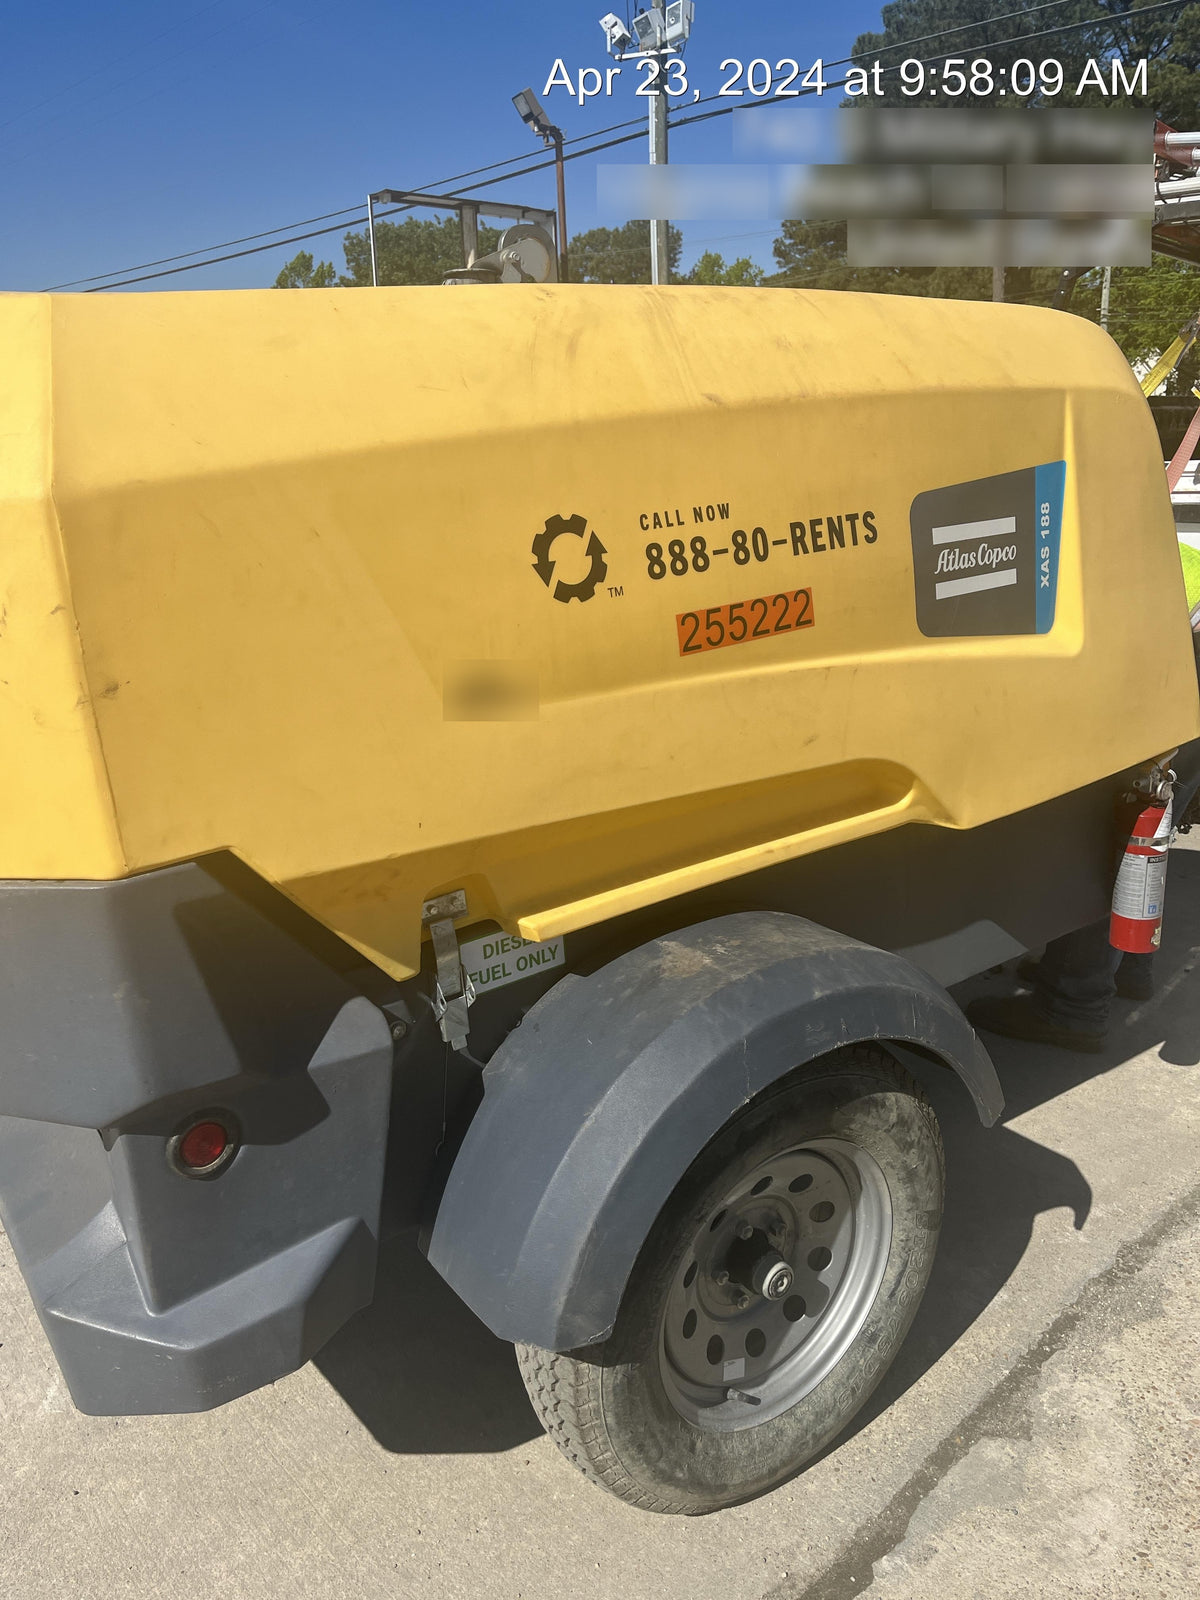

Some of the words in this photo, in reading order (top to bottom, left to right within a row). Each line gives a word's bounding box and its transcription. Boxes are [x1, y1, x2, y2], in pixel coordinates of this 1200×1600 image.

[639, 509, 685, 531] CALL
[692, 503, 730, 523] NOW
[1040, 502, 1050, 539] 188
[645, 511, 878, 580] 888-80-RENTS
[934, 548, 976, 575] Atlas
[977, 543, 1017, 568] Copco
[1040, 546, 1050, 588] XAS
[607, 586, 624, 598] TM
[680, 589, 813, 652] 255222
[469, 962, 512, 985] FUEL
[516, 944, 558, 971] ONLY
